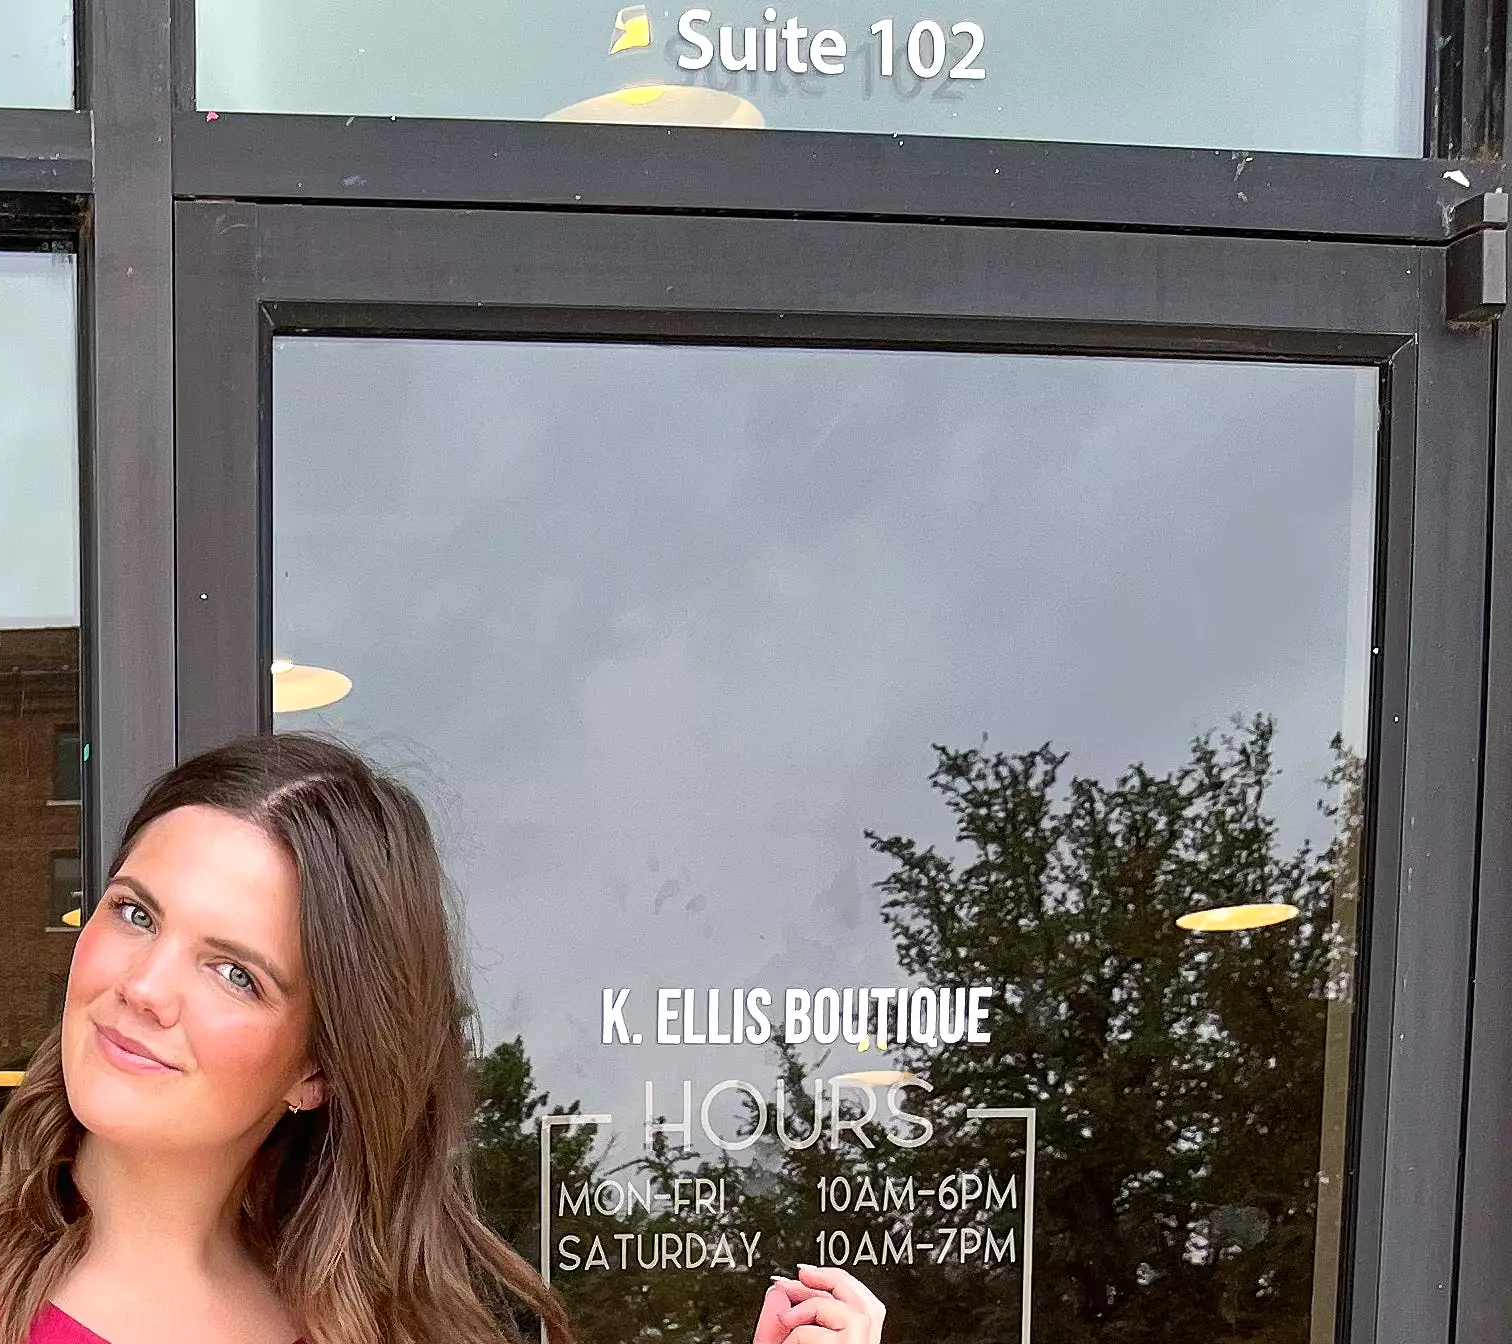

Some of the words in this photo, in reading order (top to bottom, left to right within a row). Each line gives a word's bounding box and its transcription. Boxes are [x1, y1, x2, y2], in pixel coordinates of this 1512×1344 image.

[677, 7, 847, 74] Suite
[870, 18, 986, 80] 102
[602, 987, 643, 1045] K.
[657, 986, 772, 1045] ELLIS
[784, 986, 992, 1047] BOUTIQUE
[644, 1076, 935, 1152] HOURS
[558, 1178, 726, 1217] MON-FRI
[816, 1173, 1018, 1213] 10AM-6PM
[558, 1231, 762, 1271] SATURDAY
[815, 1227, 1017, 1266] 10AM-7PM
